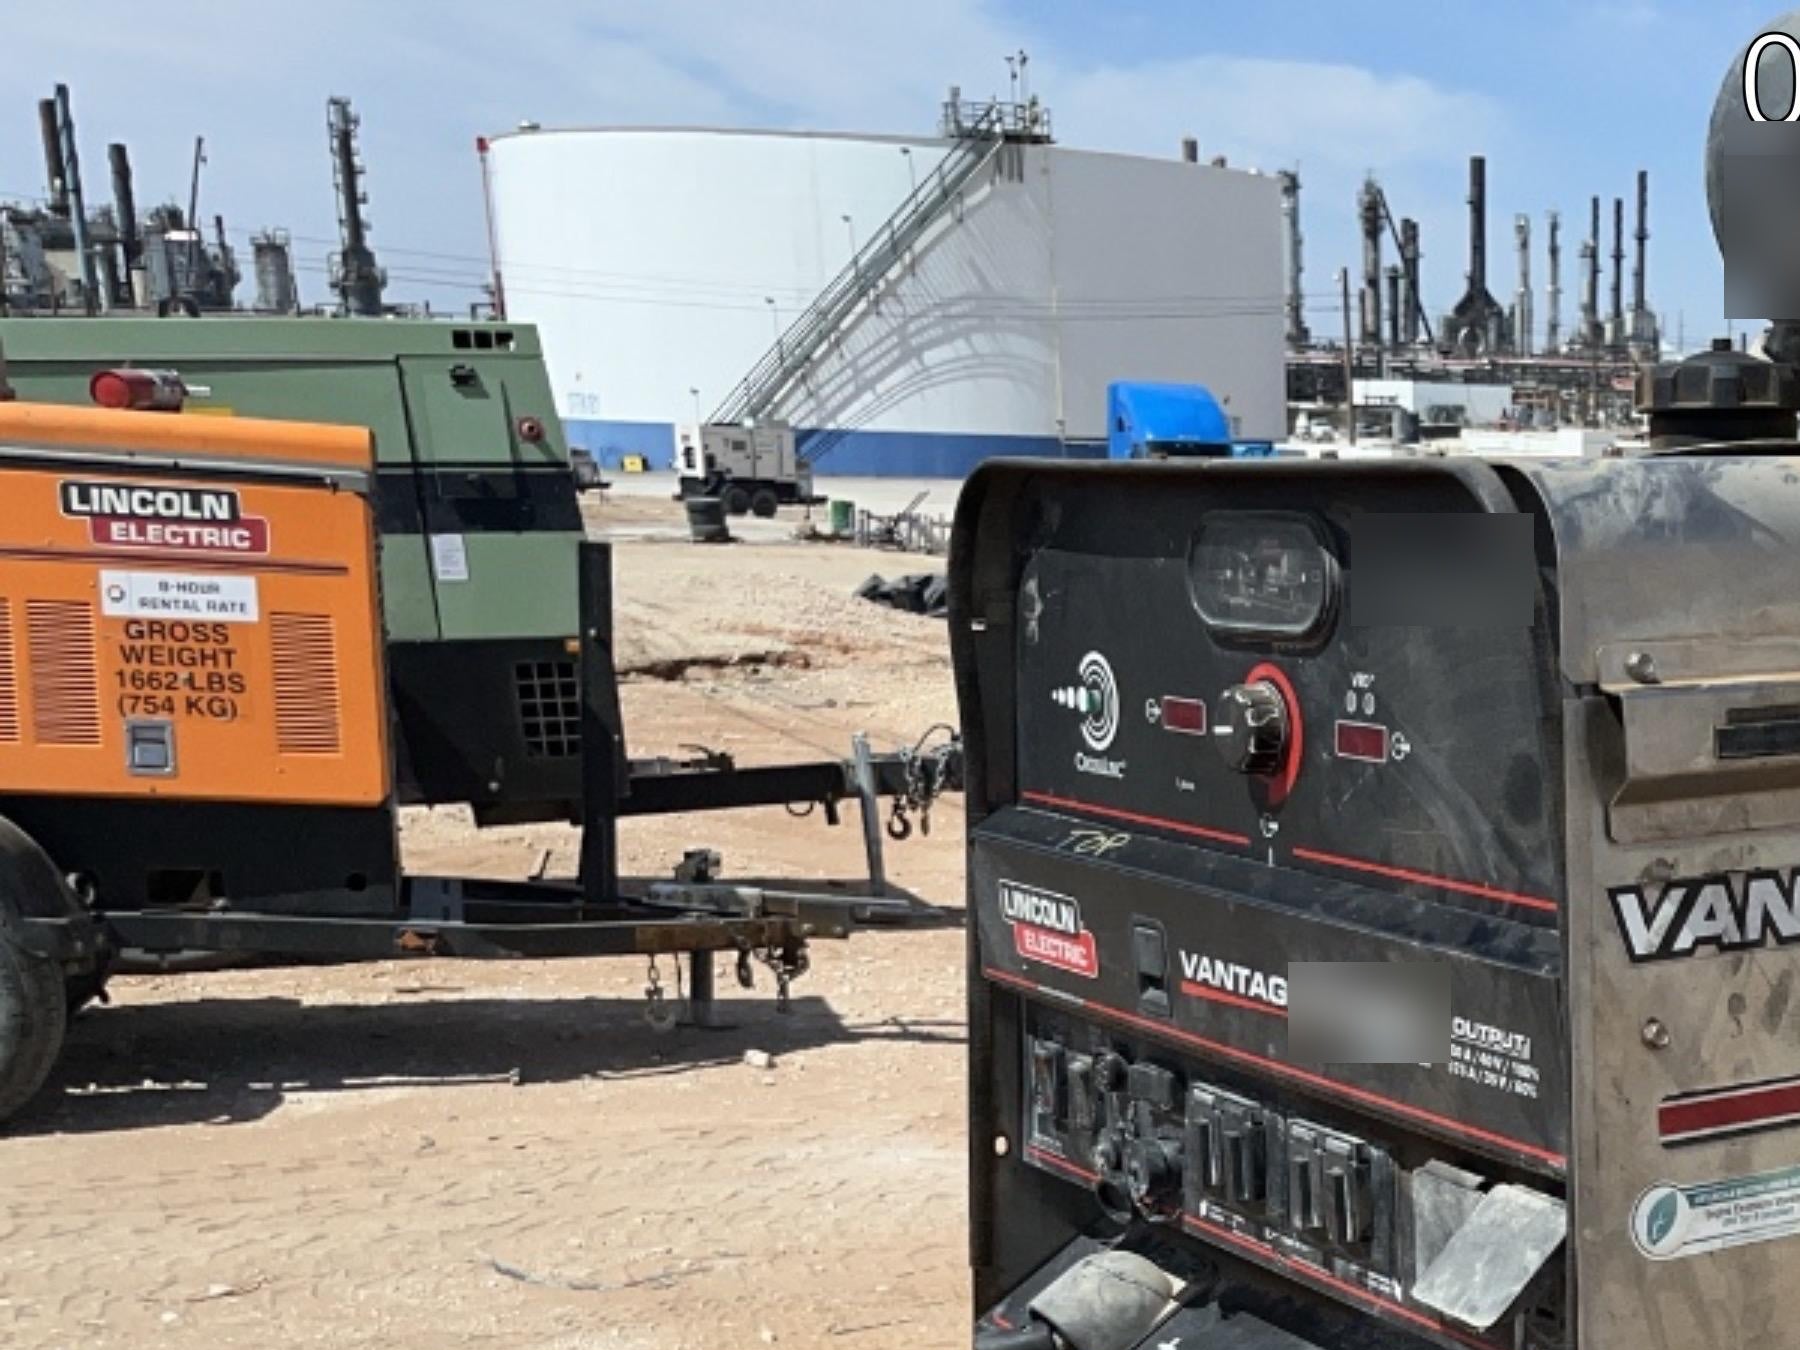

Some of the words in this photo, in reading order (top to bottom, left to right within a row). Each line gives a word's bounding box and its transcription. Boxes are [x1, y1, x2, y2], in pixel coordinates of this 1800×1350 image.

[69, 486, 231, 520] LINCOLN
[110, 522, 252, 548] ELECTRIC
[138, 597, 202, 612] RENTAL
[206, 600, 248, 614] RATE
[124, 619, 230, 645] GROSS
[119, 644, 237, 669] WEIGHT
[115, 669, 180, 691] 1662
[187, 671, 246, 694] LBS
[117, 692, 176, 718] (754
[185, 695, 238, 719] KG)
[1003, 886, 1076, 934] LINCOLN
[1022, 928, 1087, 968] ELECTRIC
[1178, 949, 1288, 1006] VANTAG
